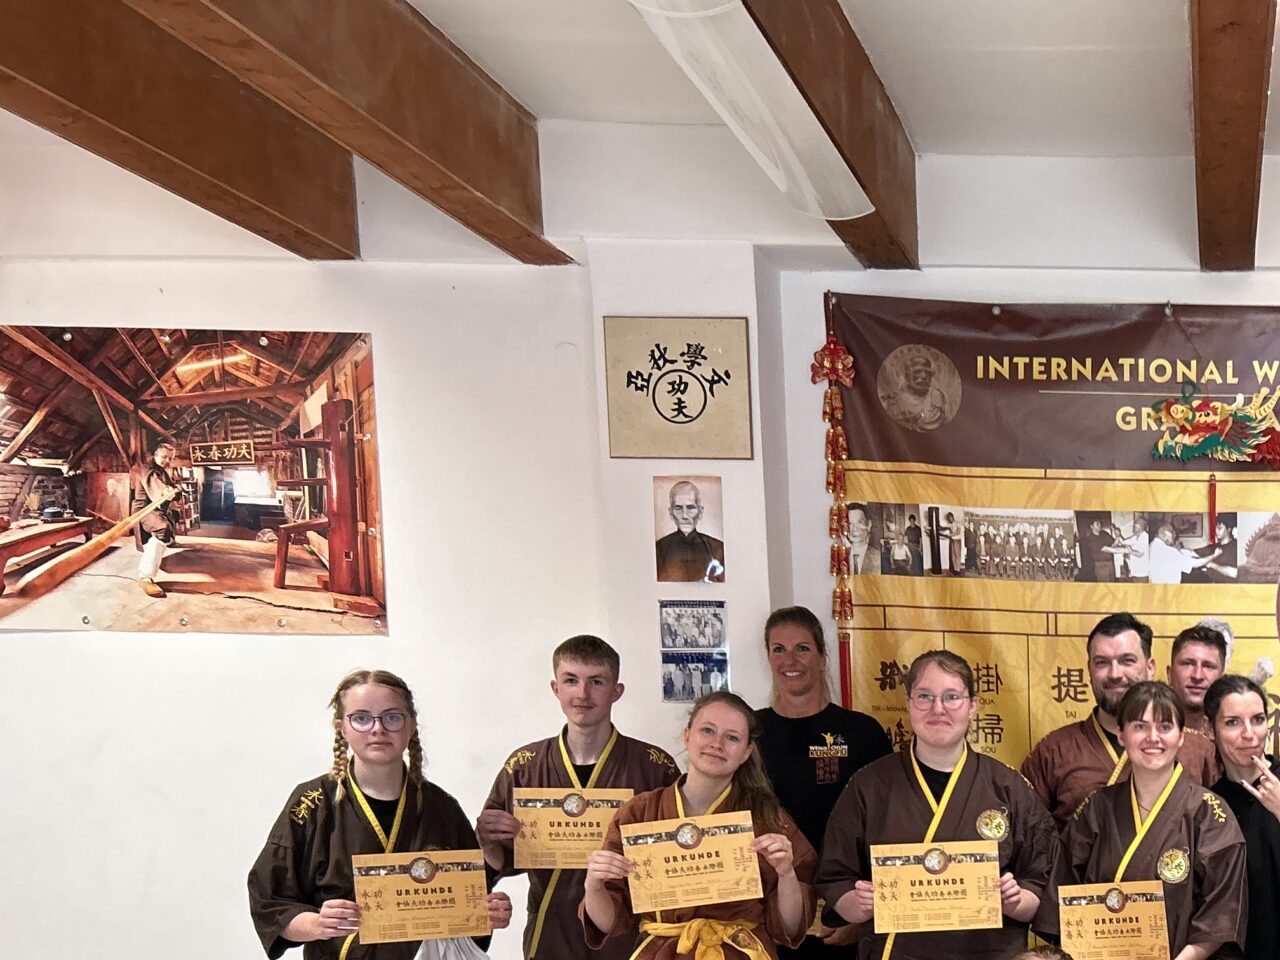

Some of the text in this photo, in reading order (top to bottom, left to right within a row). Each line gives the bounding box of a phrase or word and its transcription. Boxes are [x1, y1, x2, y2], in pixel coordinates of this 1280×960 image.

[976, 355, 1239, 385] INTERNATIONAL
[192, 443, 251, 461] 永春功夫
[1050, 666, 1090, 704] 提
[1065, 711, 1077, 719] TAI
[664, 850, 720, 863] URKUNDE
[910, 878, 965, 887] URKUNDE
[396, 886, 453, 896] URKUNDE
[1094, 916, 1140, 925] URKUNDE
